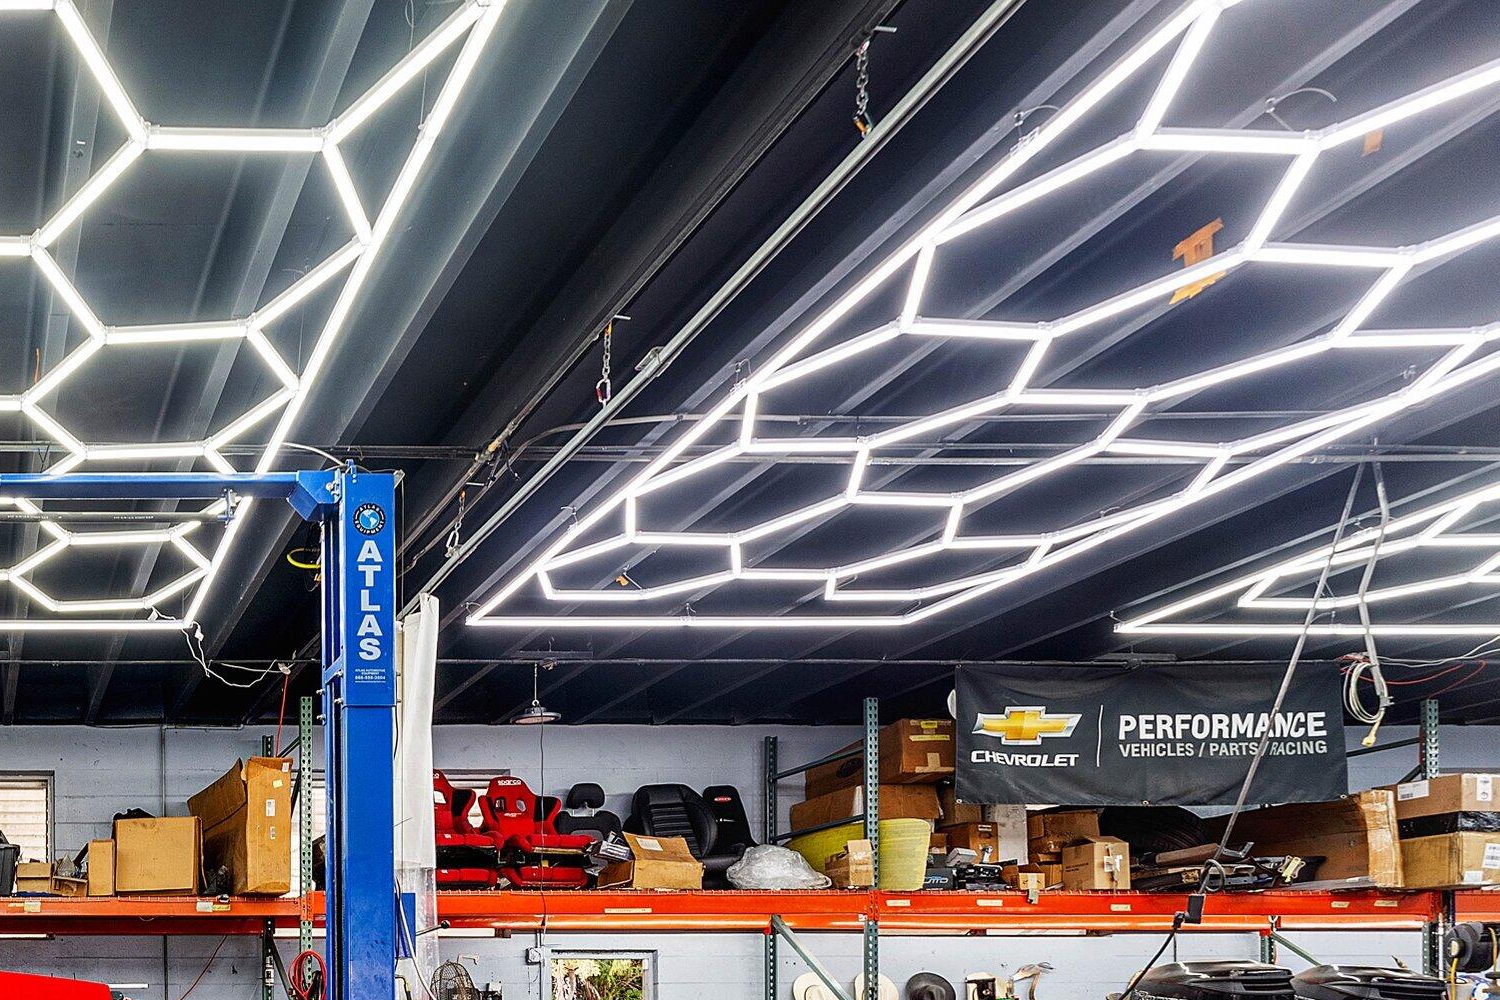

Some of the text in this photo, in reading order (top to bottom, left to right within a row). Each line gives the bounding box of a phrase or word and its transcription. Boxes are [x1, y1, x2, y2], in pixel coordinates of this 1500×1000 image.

[354, 520, 385, 534] EQUIPMENT
[356, 540, 383, 660] ATLAS
[1118, 711, 1328, 741] PERFORMANCE
[1119, 742, 1195, 758] VEHICLES
[1209, 742, 1259, 757] PARTS
[1272, 740, 1328, 756] RACING
[970, 750, 1080, 767] CHEVROLET
